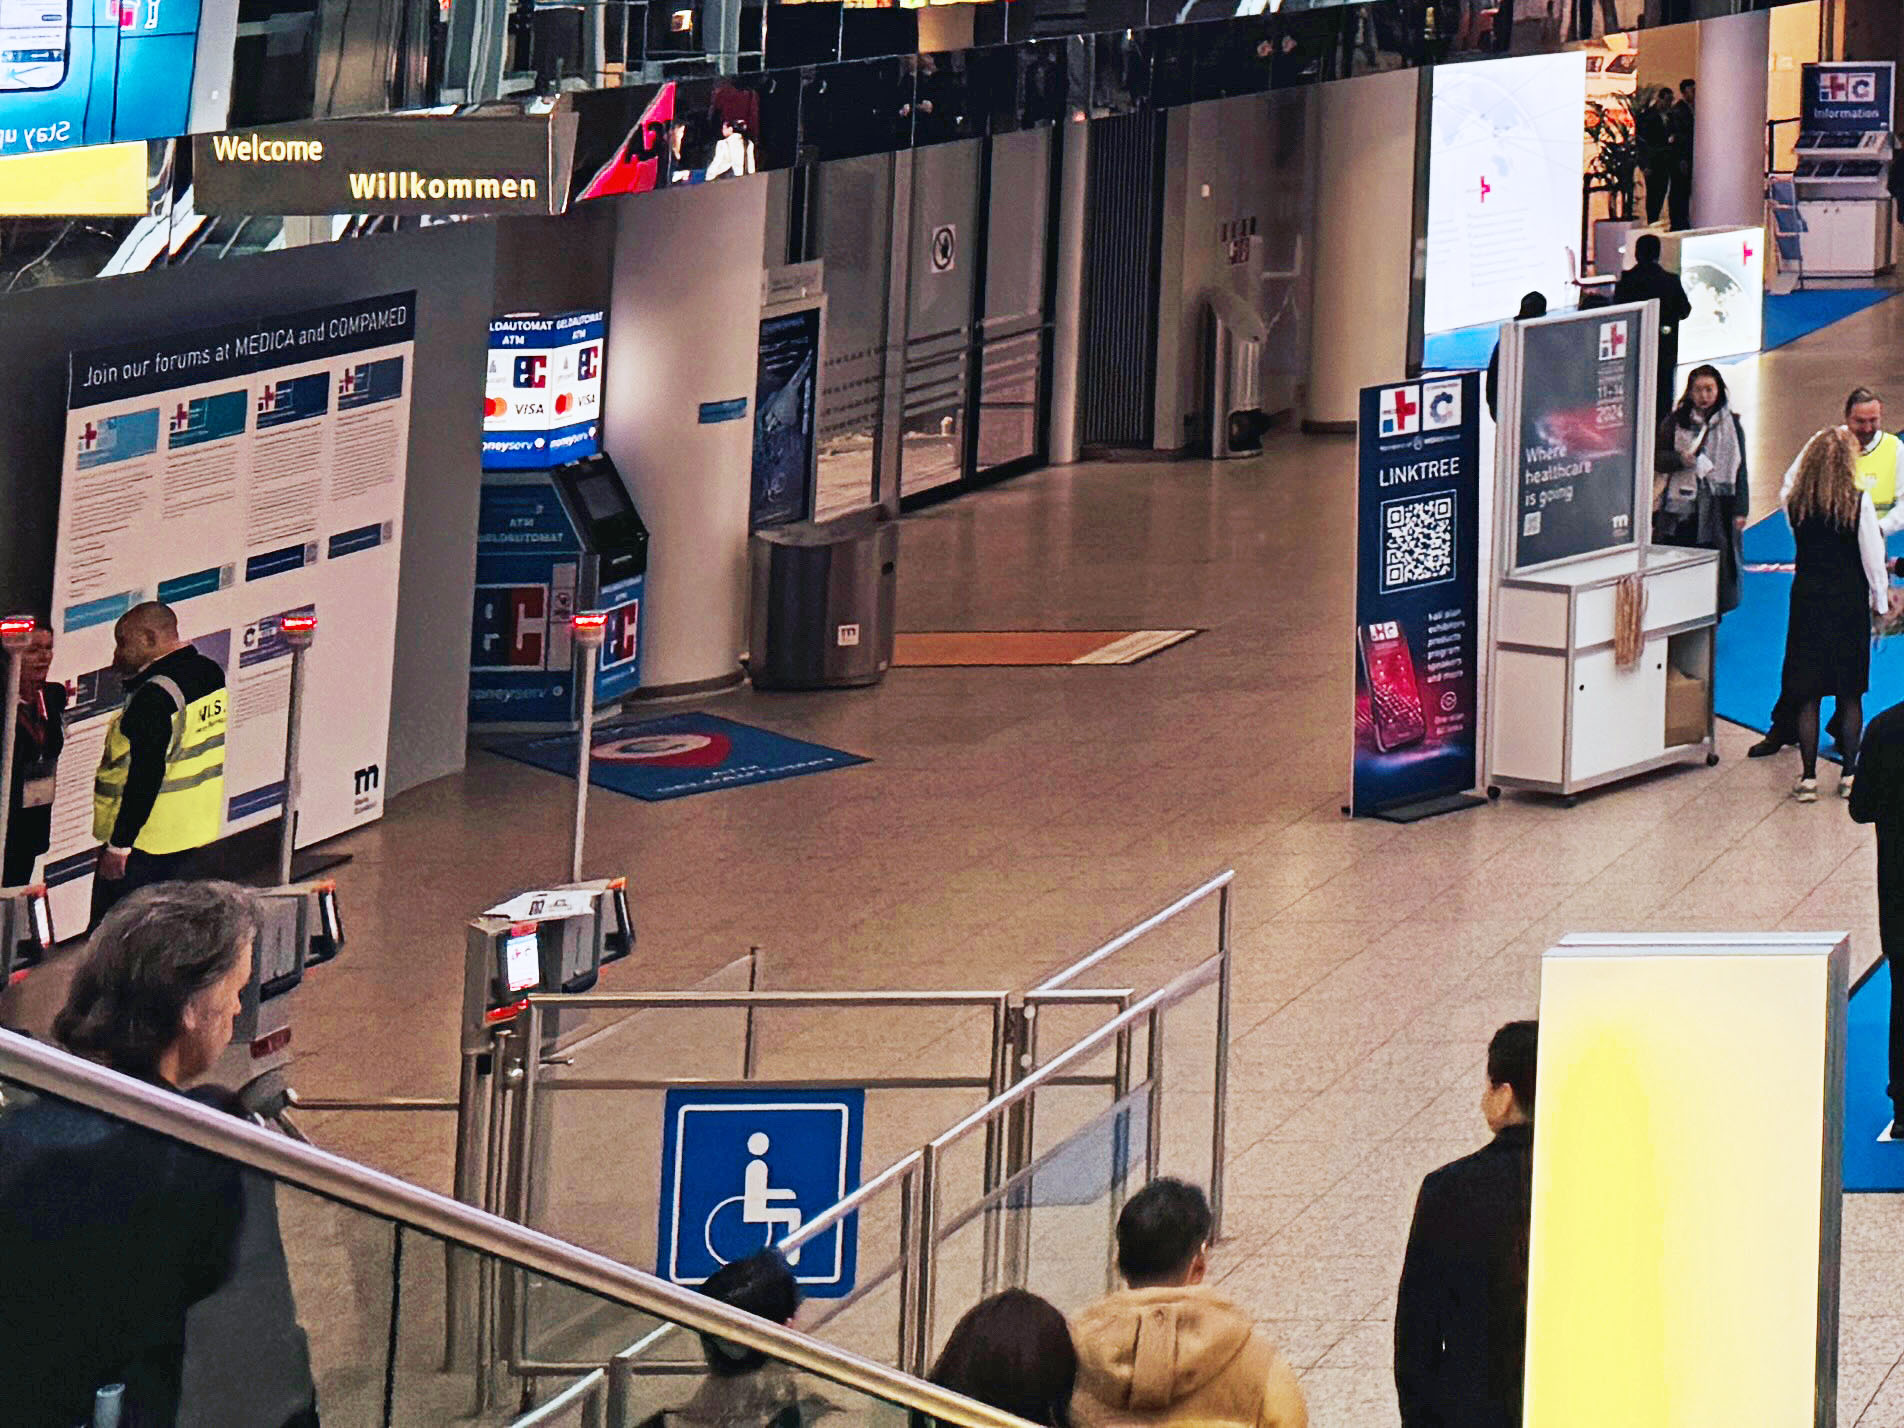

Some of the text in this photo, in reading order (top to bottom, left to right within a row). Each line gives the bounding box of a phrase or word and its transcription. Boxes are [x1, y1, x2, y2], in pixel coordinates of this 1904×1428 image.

[1813, 107, 1879, 119] Information
[213, 133, 323, 163] Welcome
[349, 172, 537, 201] Willkommen
[489, 320, 554, 332] LDAUTOMAT
[83, 305, 407, 388] Join our forums at MEDICA and COMPAMED
[502, 335, 525, 345] ATM
[515, 393, 596, 415] VISA VISA
[1525, 443, 1568, 463] Where
[1379, 456, 1461, 487] LINKTREE
[1525, 459, 1592, 486] healthcare
[1525, 484, 1575, 508] is going
